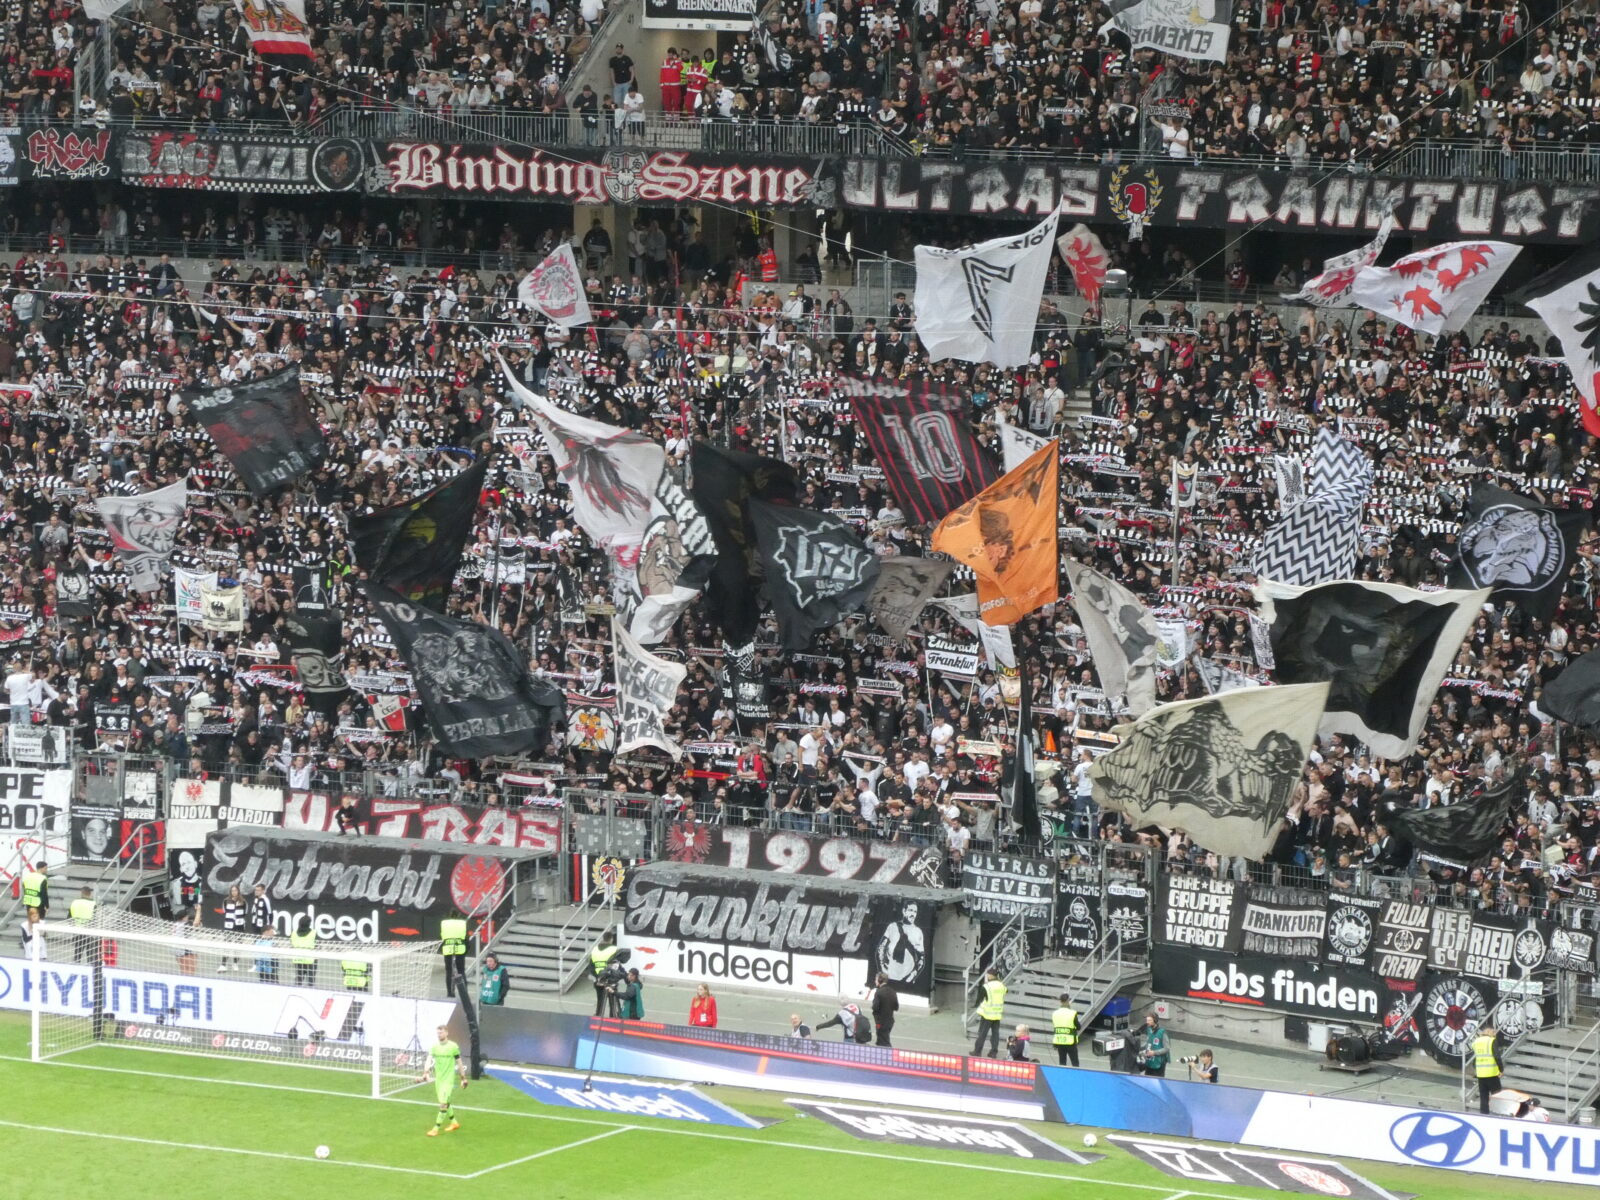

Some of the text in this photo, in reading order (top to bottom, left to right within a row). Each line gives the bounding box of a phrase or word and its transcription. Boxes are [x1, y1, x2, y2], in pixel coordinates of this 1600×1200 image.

[27, 127, 111, 170] CREW
[121, 138, 309, 180] RAGAZZI
[389, 143, 809, 204] Binding Szene
[843, 161, 1599, 238] ULTRAS FRANKFURT
[501, 414, 515, 425] 20
[882, 411, 966, 483] 10
[928, 635, 979, 655] Eintracht
[927, 652, 976, 671] Frankfurt
[171, 805, 275, 825] NUOVA GUARDIA
[283, 792, 561, 851] ULTRAS
[722, 827, 919, 885] 1997
[972, 853, 1049, 878] ULTRAS
[207, 836, 441, 909] Eintracht
[1169, 875, 1235, 895] EHRE DER
[975, 875, 1042, 898] NEVER
[1060, 882, 1100, 897] EXTREME
[626, 868, 873, 952] Frankfurt
[962, 895, 1049, 919] SURRENDER
[1168, 888, 1233, 915] GRUPPE
[1166, 908, 1230, 931] STADION
[1247, 910, 1324, 933] FRANKFURT
[1384, 901, 1430, 928] FULDA
[1432, 909, 1471, 934] REG
[1064, 937, 1095, 949] FANS
[1166, 923, 1228, 949] VERBOT
[1384, 932, 1424, 951] 3 6
[1469, 927, 1515, 961] RIED
[678, 939, 794, 985] indeed
[1379, 955, 1423, 980] CREW
[1465, 954, 1511, 979] GEBIET
[23, 967, 214, 1021] HYUNDAI
[1190, 960, 1379, 1014] Jobs finden
[136, 1027, 152, 1039] LG
[153, 1029, 181, 1042] OLED
[224, 1037, 240, 1048] LG
[241, 1039, 270, 1053] OLED
[315, 1046, 330, 1058] LG
[332, 1048, 361, 1061] OLED
[816, 1103, 1034, 1159] betway
